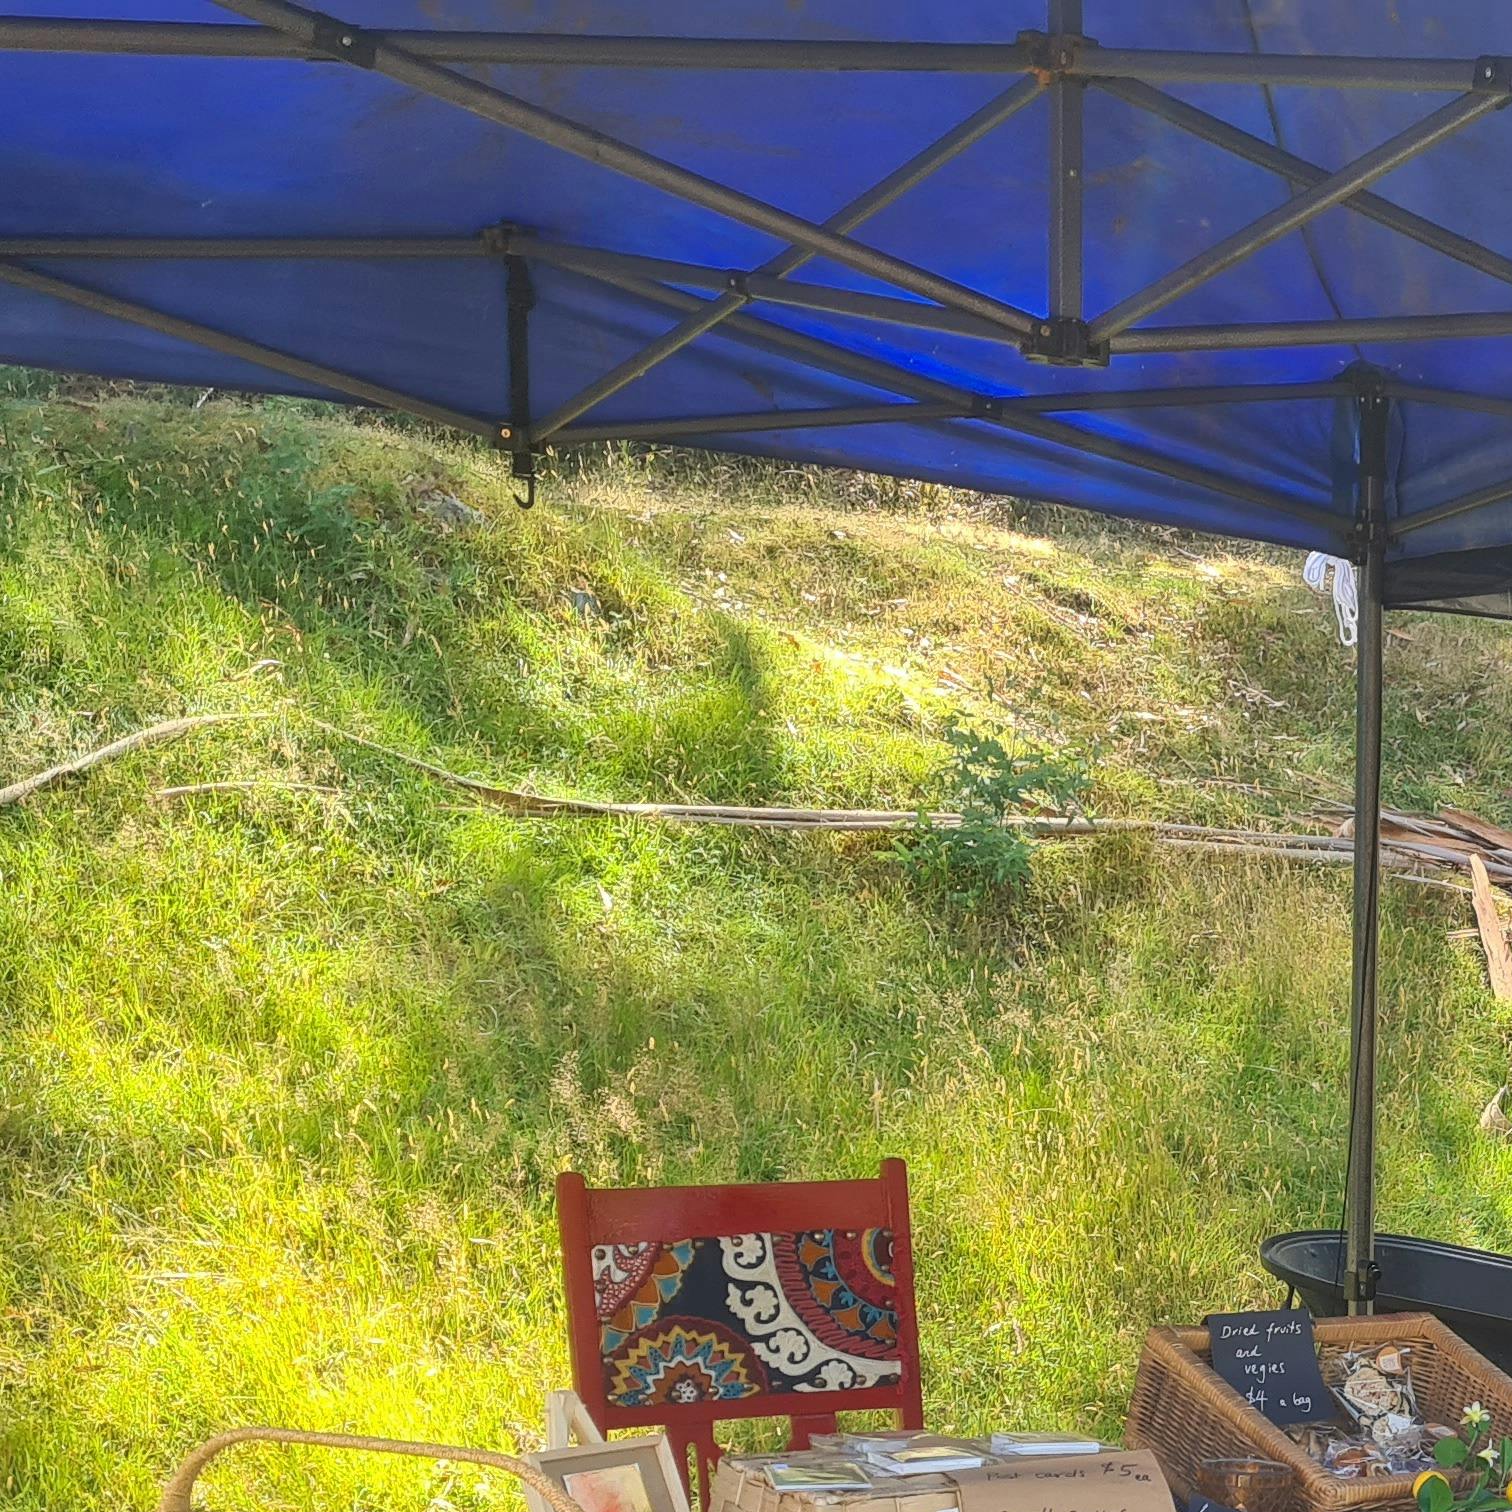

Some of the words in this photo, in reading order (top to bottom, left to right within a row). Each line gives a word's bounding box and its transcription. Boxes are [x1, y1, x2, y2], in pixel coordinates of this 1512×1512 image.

[1265, 1322, 1302, 1342] fruits
[1235, 1345, 1262, 1359] and
[1244, 1362, 1286, 1384] vegies
[1245, 1387, 1268, 1411] $4
[1279, 1398, 1287, 1407] a
[1292, 1392, 1312, 1413] bag
